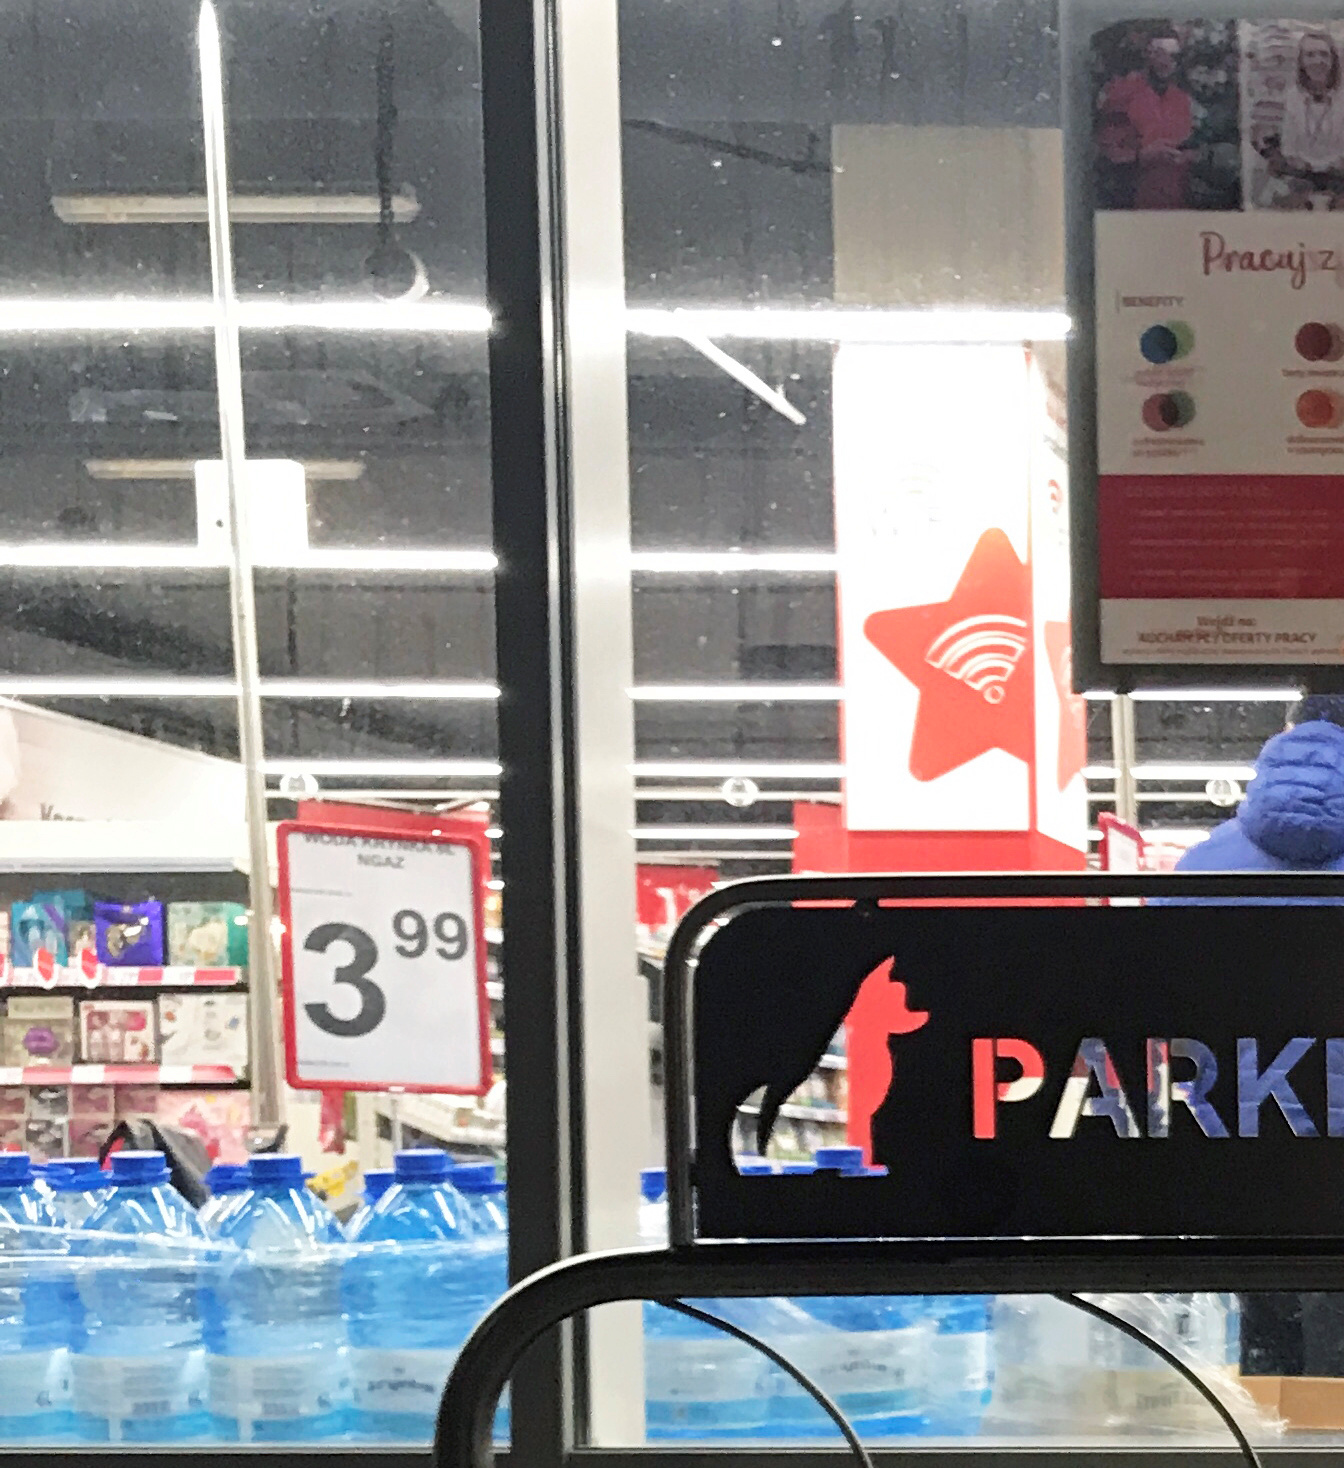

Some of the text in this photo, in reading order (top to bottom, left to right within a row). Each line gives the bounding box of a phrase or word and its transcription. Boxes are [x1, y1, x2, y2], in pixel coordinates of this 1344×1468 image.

[1201, 231, 1307, 289] Pracuj
[1319, 248, 1336, 271] z
[304, 909, 469, 1038] 3 99
